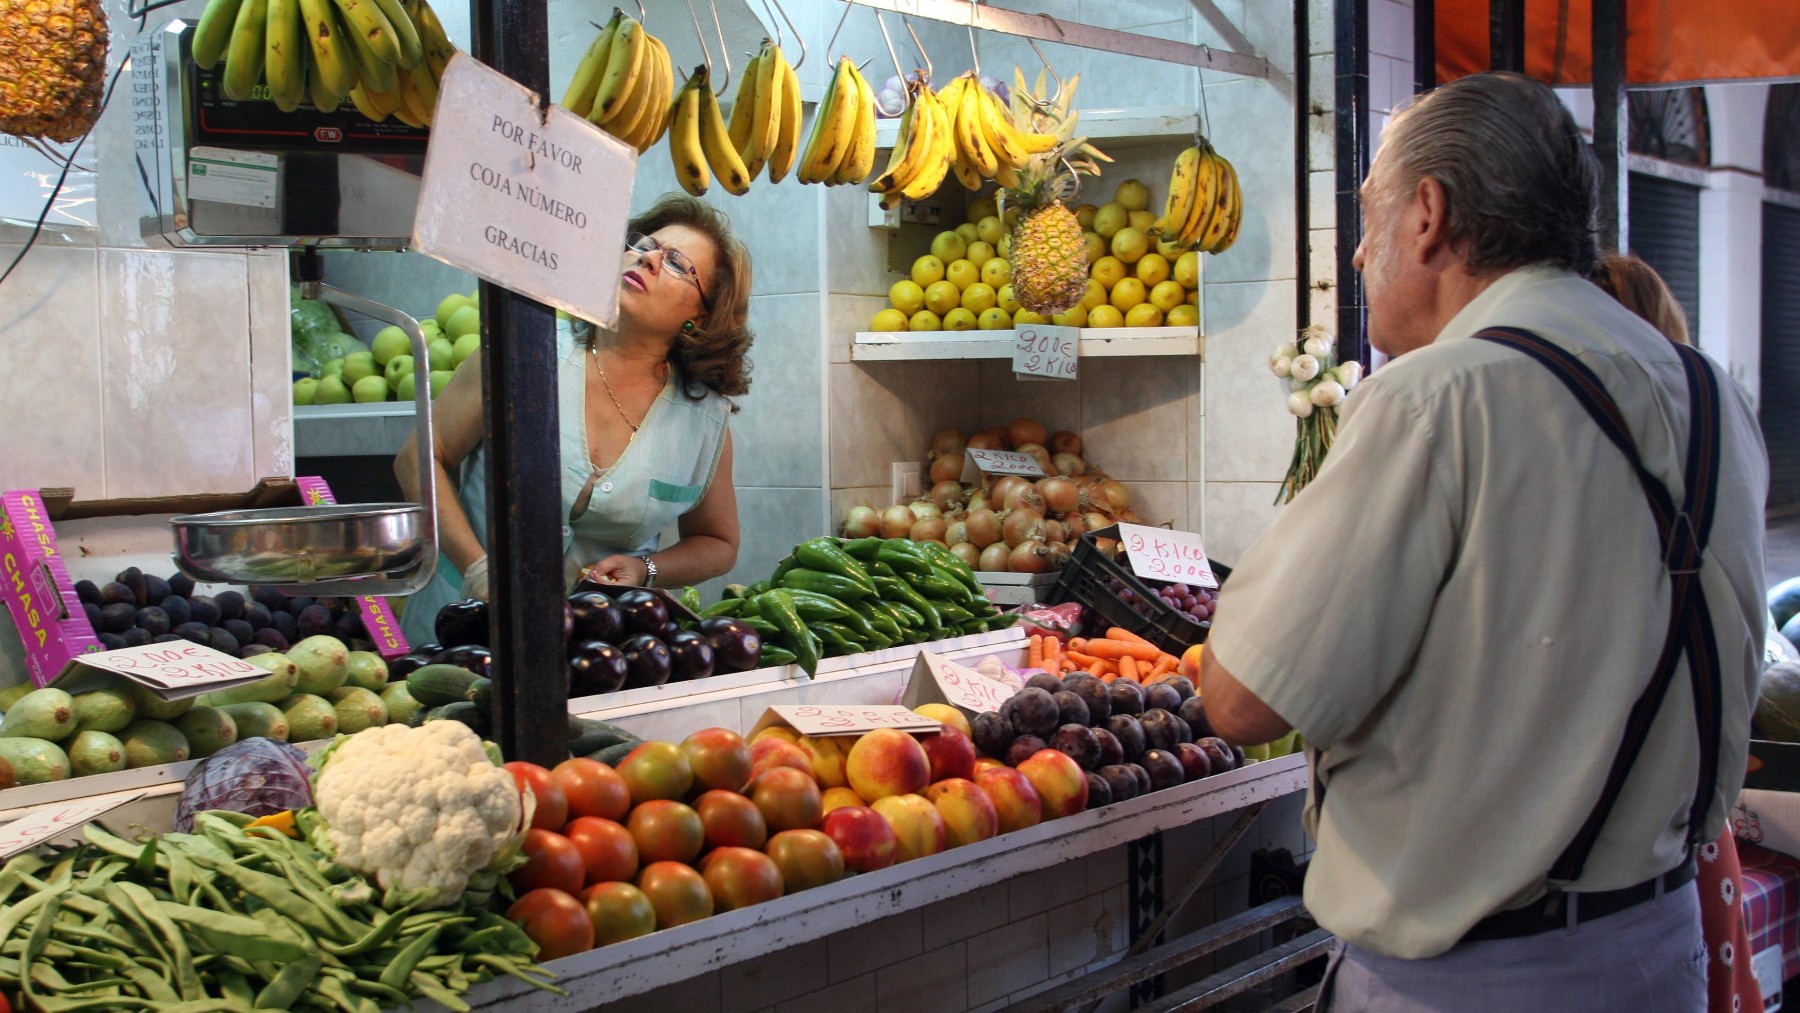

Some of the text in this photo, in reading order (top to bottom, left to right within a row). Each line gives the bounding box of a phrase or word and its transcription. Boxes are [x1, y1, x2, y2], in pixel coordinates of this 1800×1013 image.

[491, 113, 583, 175] POR FAVOR
[470, 162, 587, 230] COJA NÚMERO
[485, 225, 559, 271] GRACIAS
[1023, 355, 1076, 375] 2 KILO
[974, 450, 1027, 462] 2 KILO
[21, 494, 56, 559] CHASA
[1129, 533, 1203, 561] 2 KILO
[3, 552, 48, 650] CHASA
[161, 665, 202, 679] 2
[938, 663, 967, 692] 2
[820, 717, 856, 727] 2
